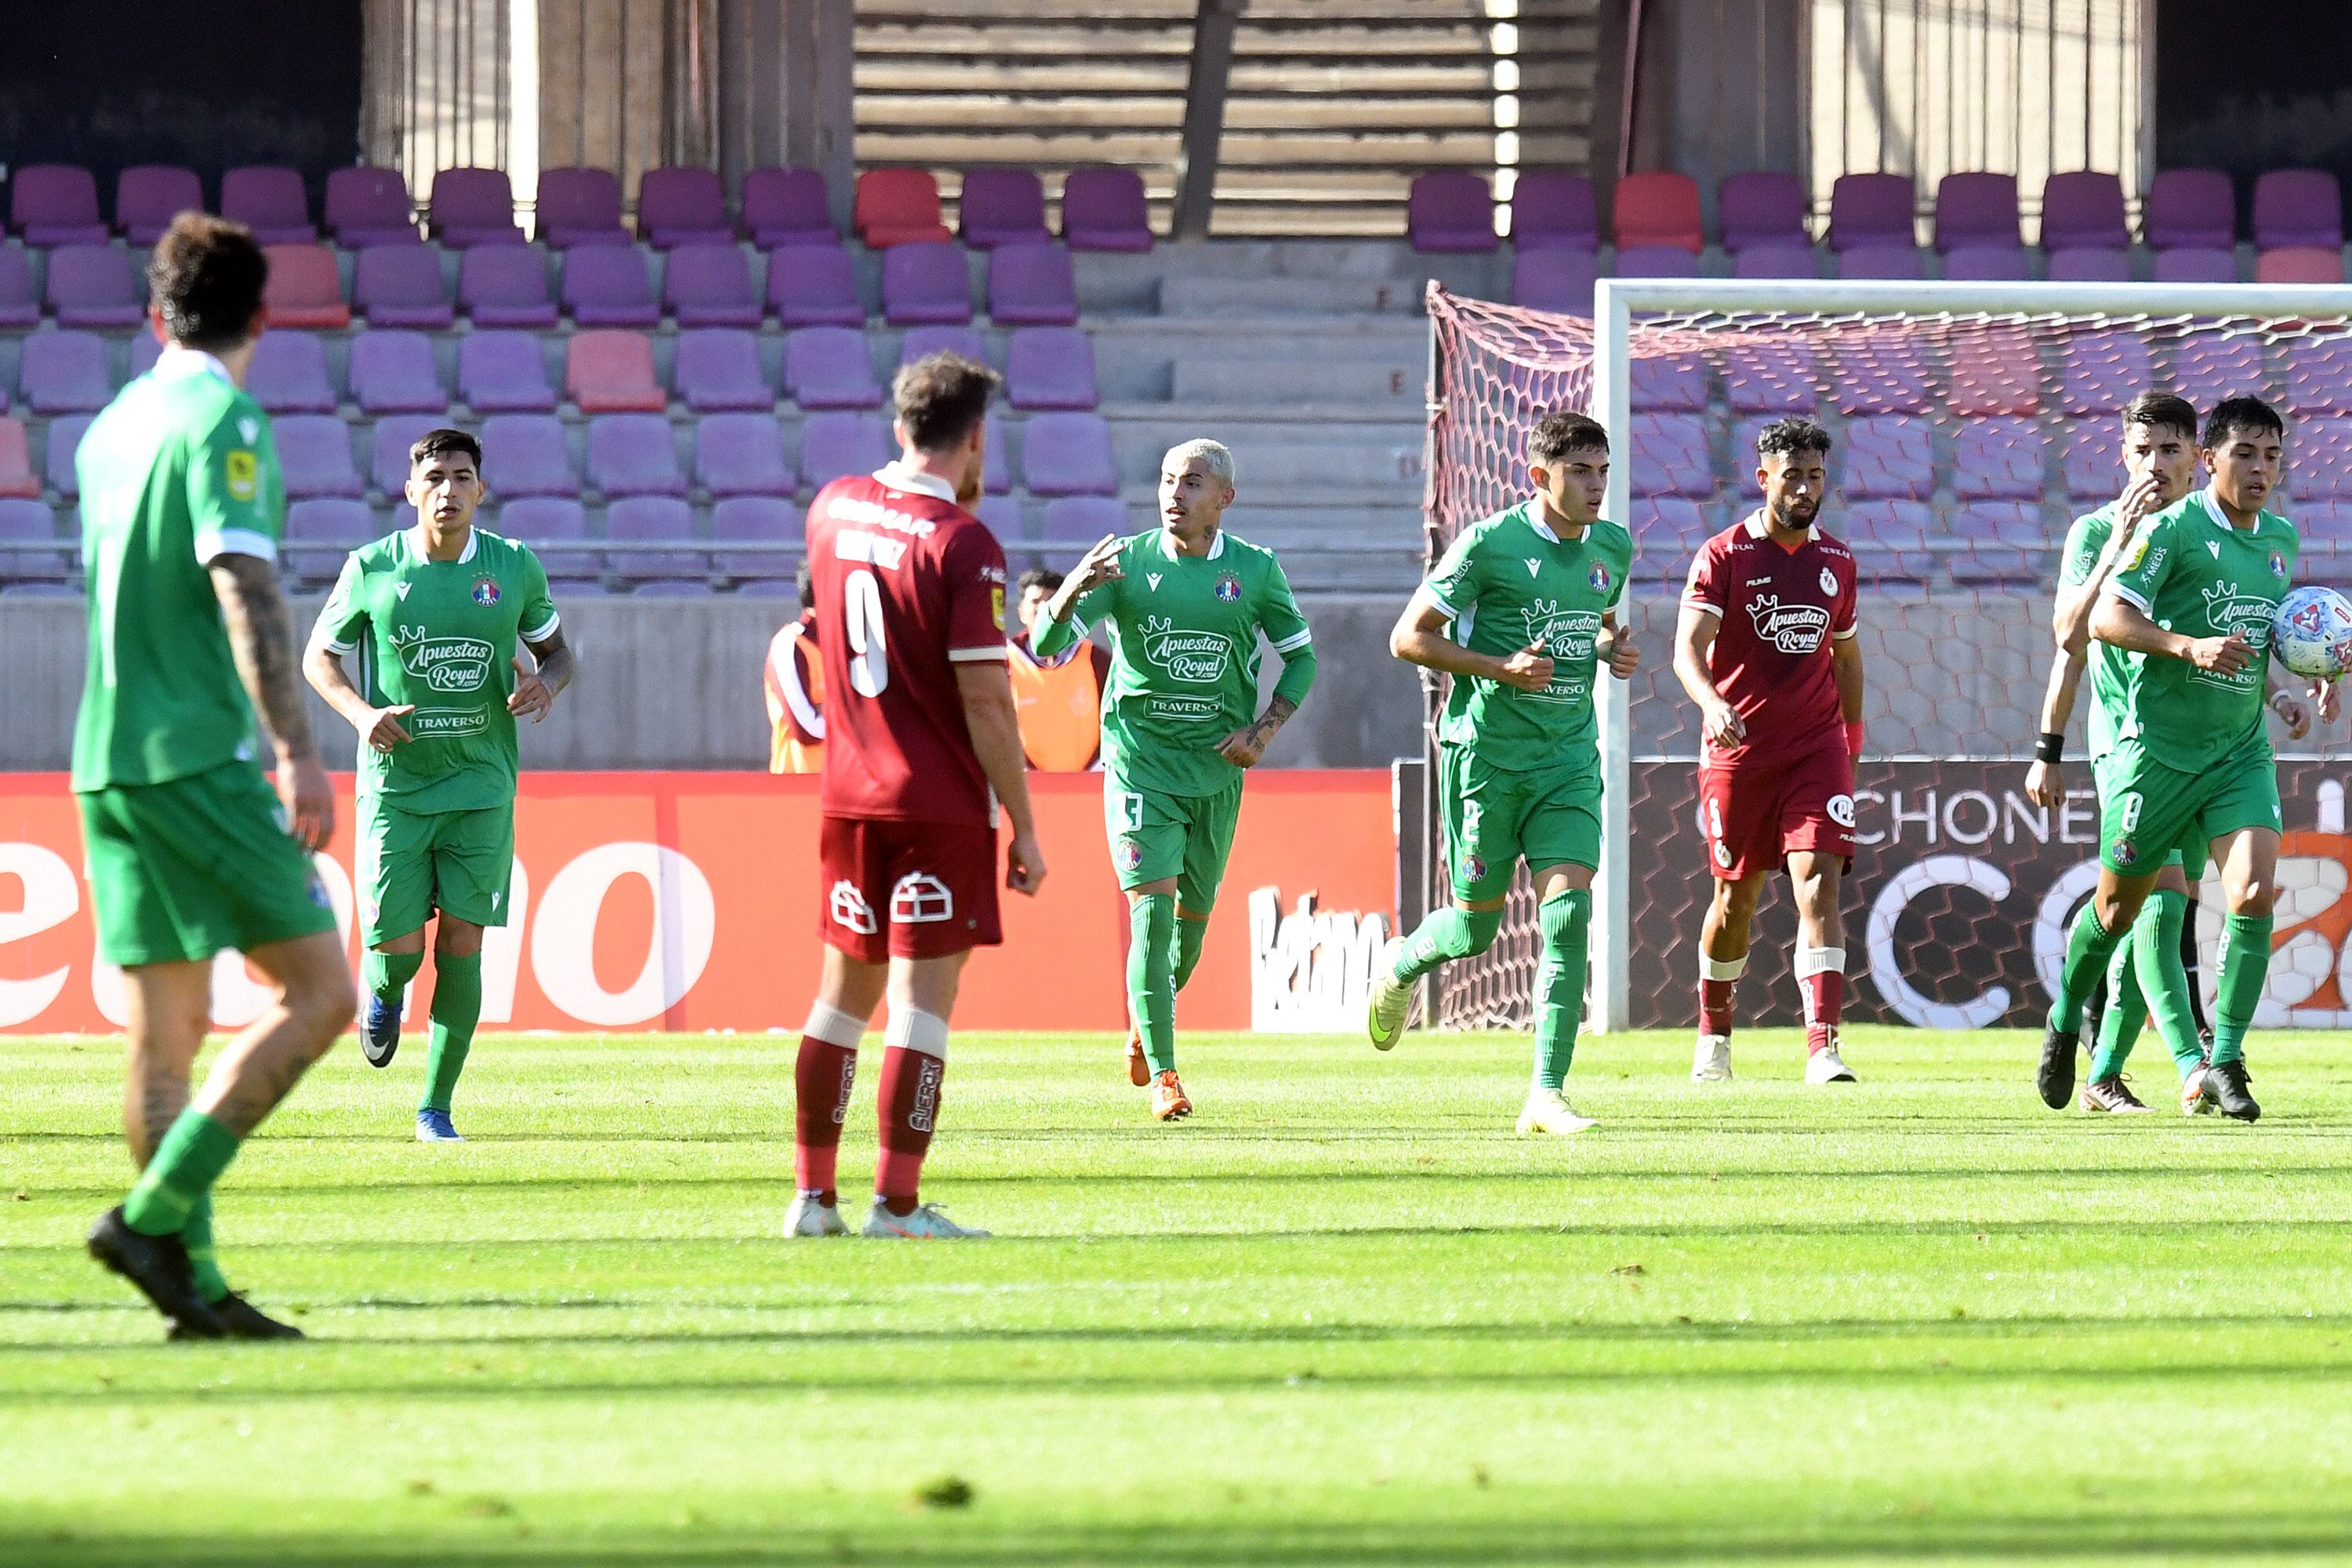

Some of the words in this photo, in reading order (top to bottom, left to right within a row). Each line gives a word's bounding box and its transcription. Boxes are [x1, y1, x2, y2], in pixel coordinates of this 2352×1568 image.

[2148, 547, 2167, 576] MEDS
[845, 569, 888, 698] 9
[1535, 615, 1599, 640] Apuestas
[1761, 609, 1826, 635] Apuestas
[1152, 636, 1226, 659] Apuestas
[1780, 630, 1820, 650] Royal
[408, 641, 488, 670] Apuestas
[433, 664, 482, 688] Royal
[1173, 657, 1220, 679] Royal
[1537, 684, 1584, 695] VERSO
[1151, 699, 1219, 712] TRAVERSO
[416, 715, 485, 728] TRAVERSO
[909, 1058, 941, 1132] SUEROX
